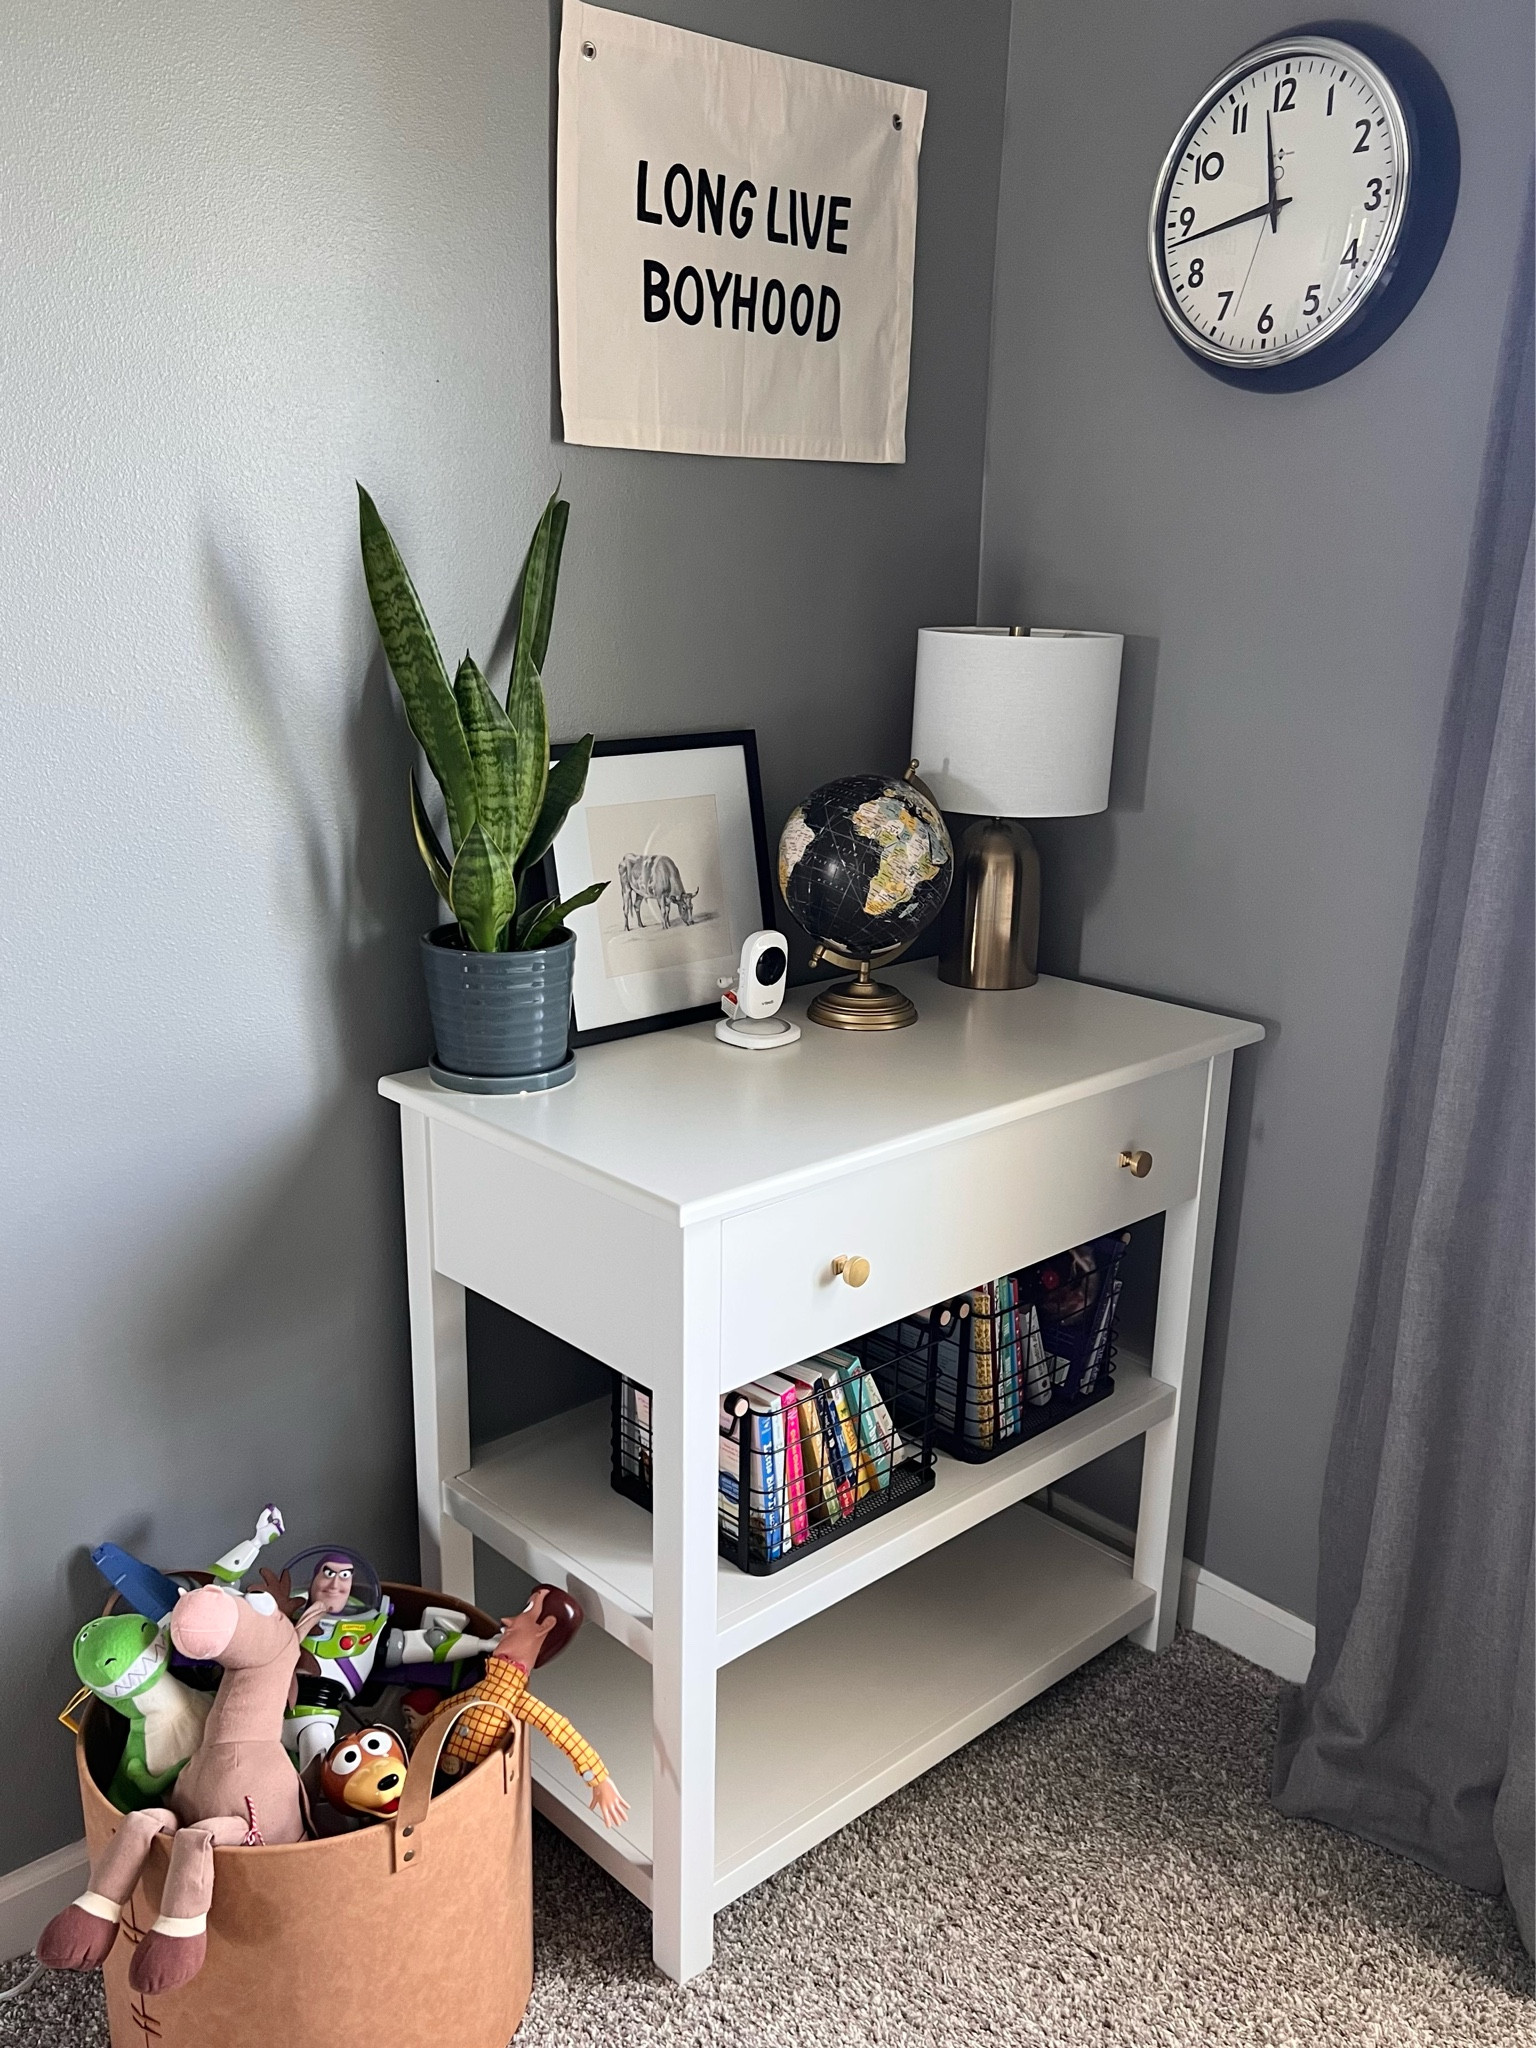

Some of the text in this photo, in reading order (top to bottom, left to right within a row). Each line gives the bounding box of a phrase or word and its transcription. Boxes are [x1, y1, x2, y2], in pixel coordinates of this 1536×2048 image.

[1274, 78, 1296, 112] 12
[1327, 83, 1335, 116] 1
[1232, 102, 1248, 134] 11
[1352, 118, 1371, 153] 2
[1194, 151, 1224, 184] 10
[637, 160, 851, 254] LONG LIVE
[1364, 177, 1382, 211] 3
[1180, 207, 1195, 237] 9
[1340, 238, 1358, 270] 4
[1188, 258, 1204, 288] 8
[644, 260, 840, 342] BOYHOOD
[1217, 291, 1233, 321] 7
[1302, 284, 1321, 316] 5
[1257, 304, 1273, 334] 6
